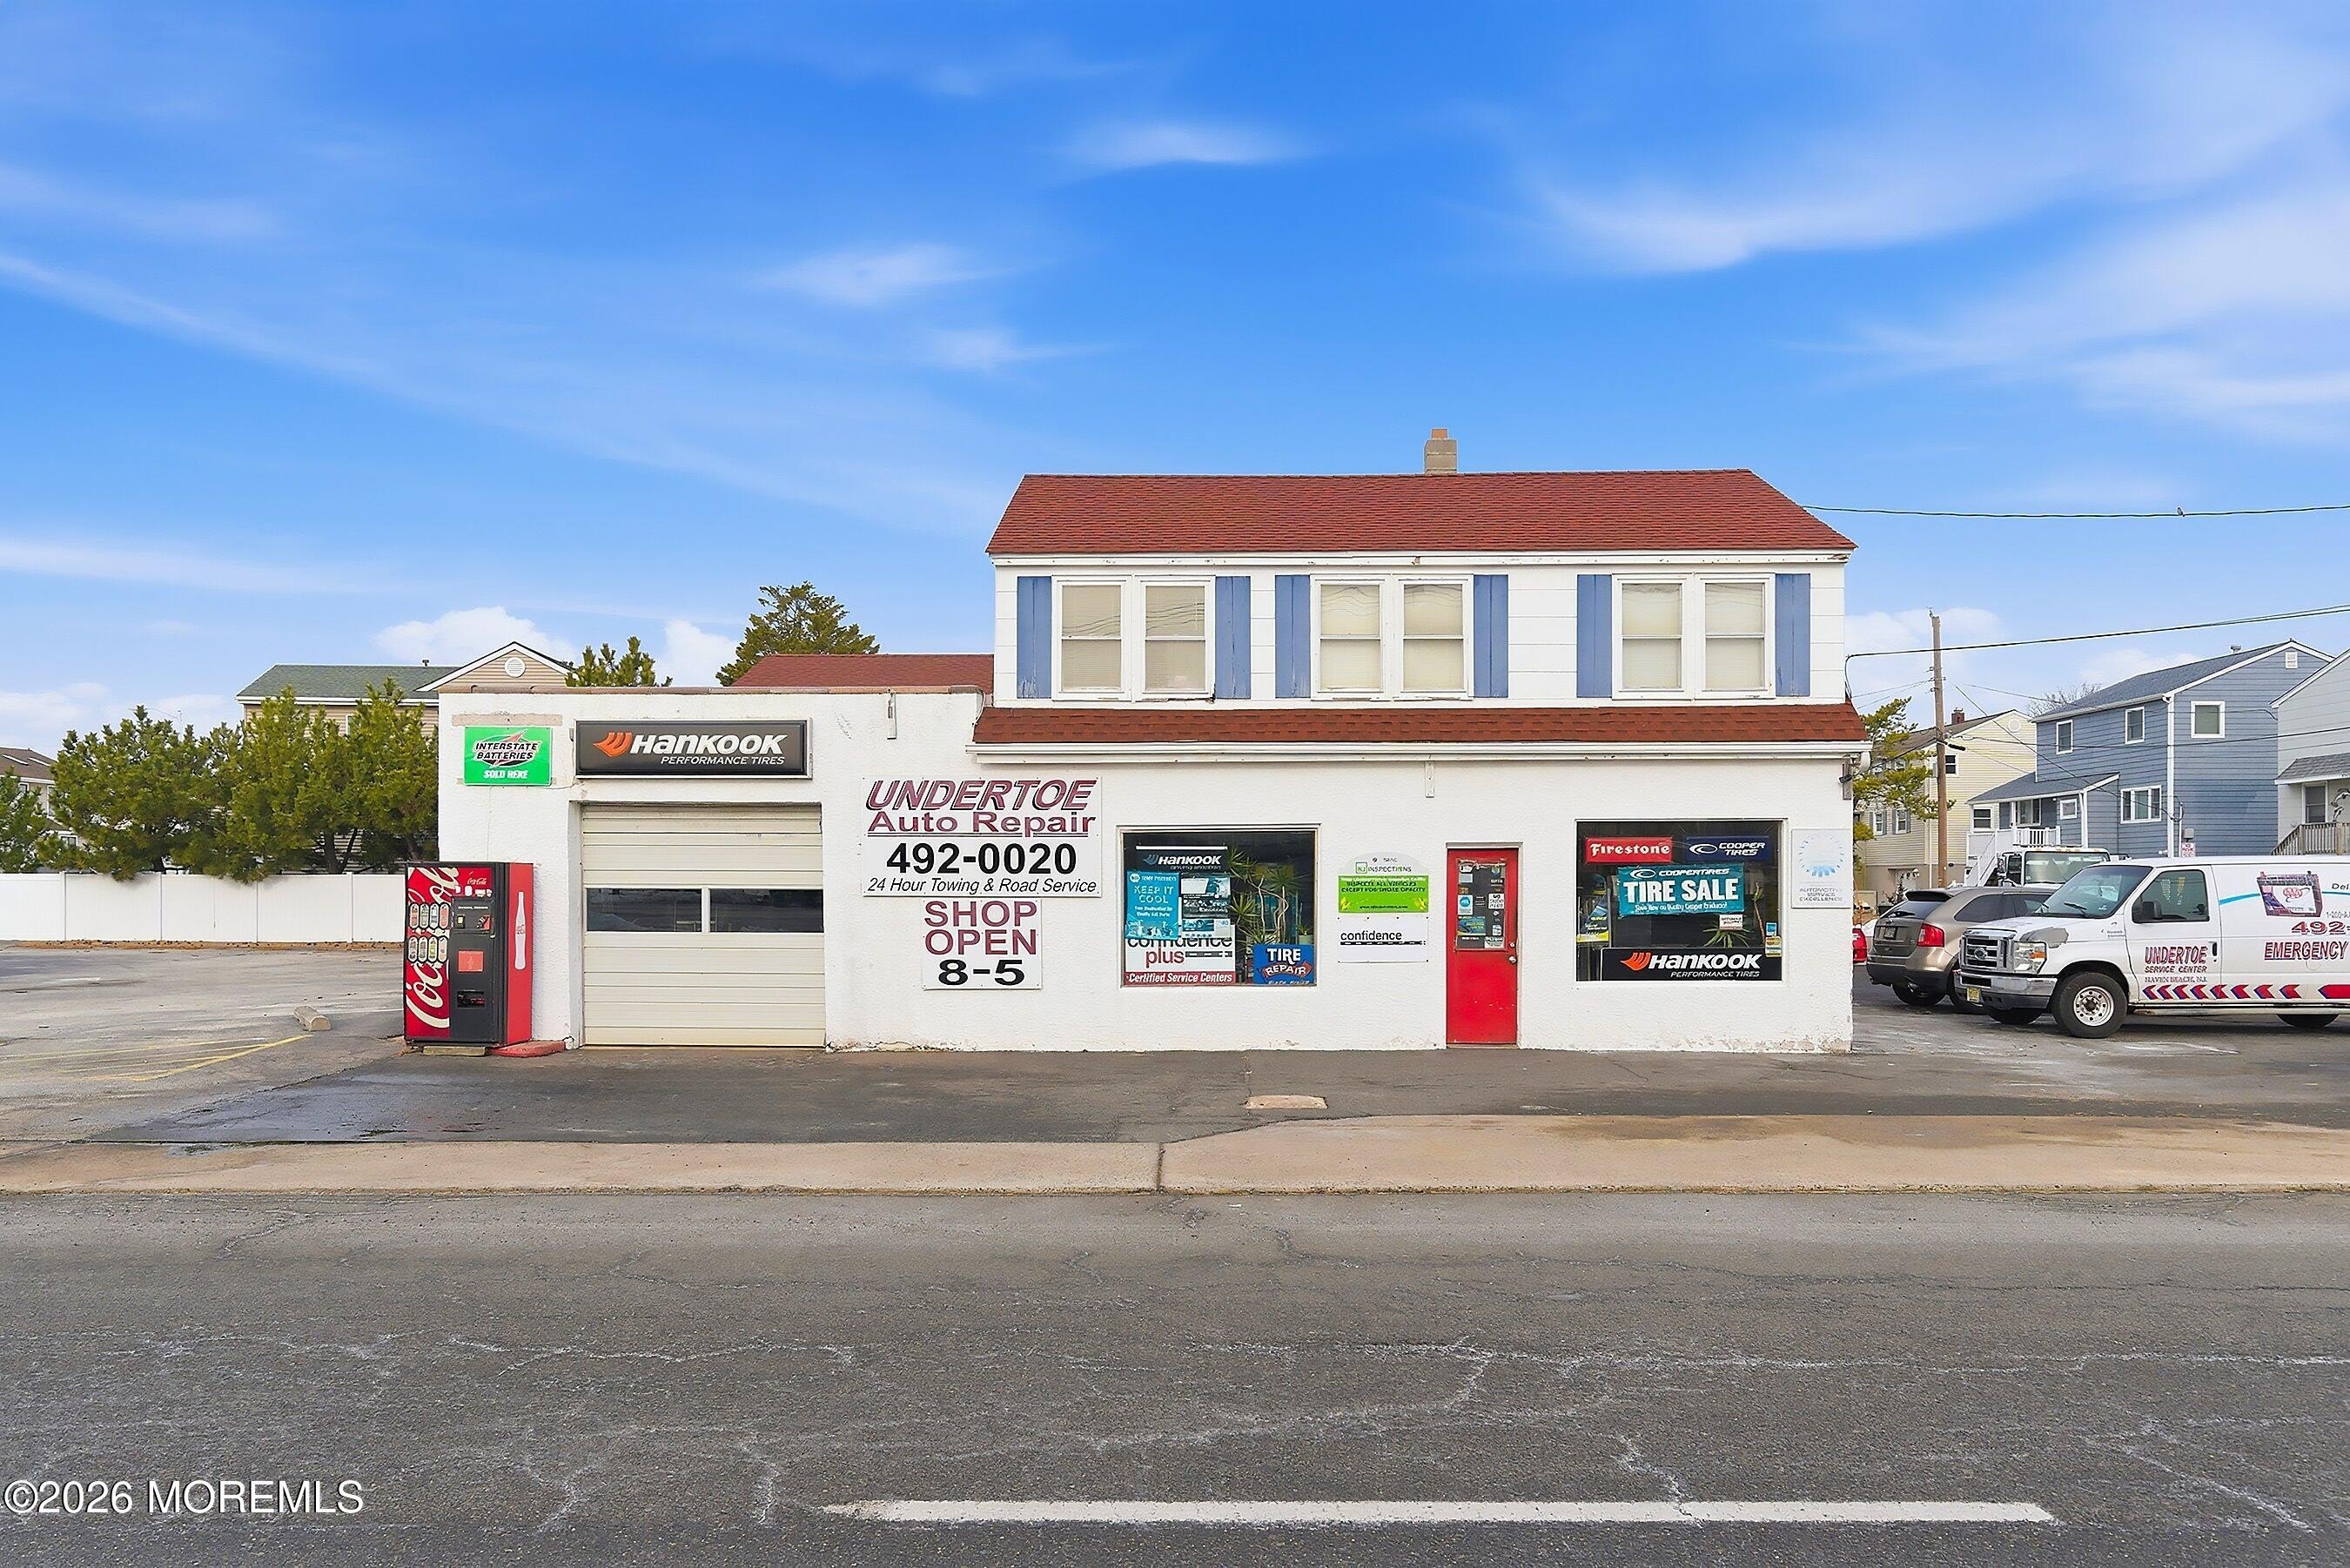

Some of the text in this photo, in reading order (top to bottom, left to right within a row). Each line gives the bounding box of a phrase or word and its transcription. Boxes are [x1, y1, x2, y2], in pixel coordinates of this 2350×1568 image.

[661, 756, 785, 765] PERFORMANCE TIRES
[865, 779, 1098, 811] UNDERTOE
[868, 811, 1097, 838] Auto Repair
[886, 842, 1078, 874] 492-0020
[1589, 842, 1671, 857] Firestone
[867, 877, 1098, 895] 24 Hour Towing & Road Service
[1133, 886, 1174, 895] KEEP IT
[1622, 878, 1739, 903] TIRE SALE
[1138, 895, 1169, 904] COOL
[923, 900, 1037, 928] SHOP
[924, 928, 1037, 955] OPEN
[1340, 930, 1402, 941] confidence
[1145, 948, 1185, 968] plus
[1266, 948, 1301, 965] TIRE
[2144, 946, 2208, 965] UNDERTOE
[2264, 941, 2349, 961] EMERGENCY
[937, 958, 1026, 987] 8-5
[1129, 971, 1233, 983] Certified Service Centers
[1265, 965, 1306, 976] REPAIR
[2144, 965, 2175, 974] SERVICE
